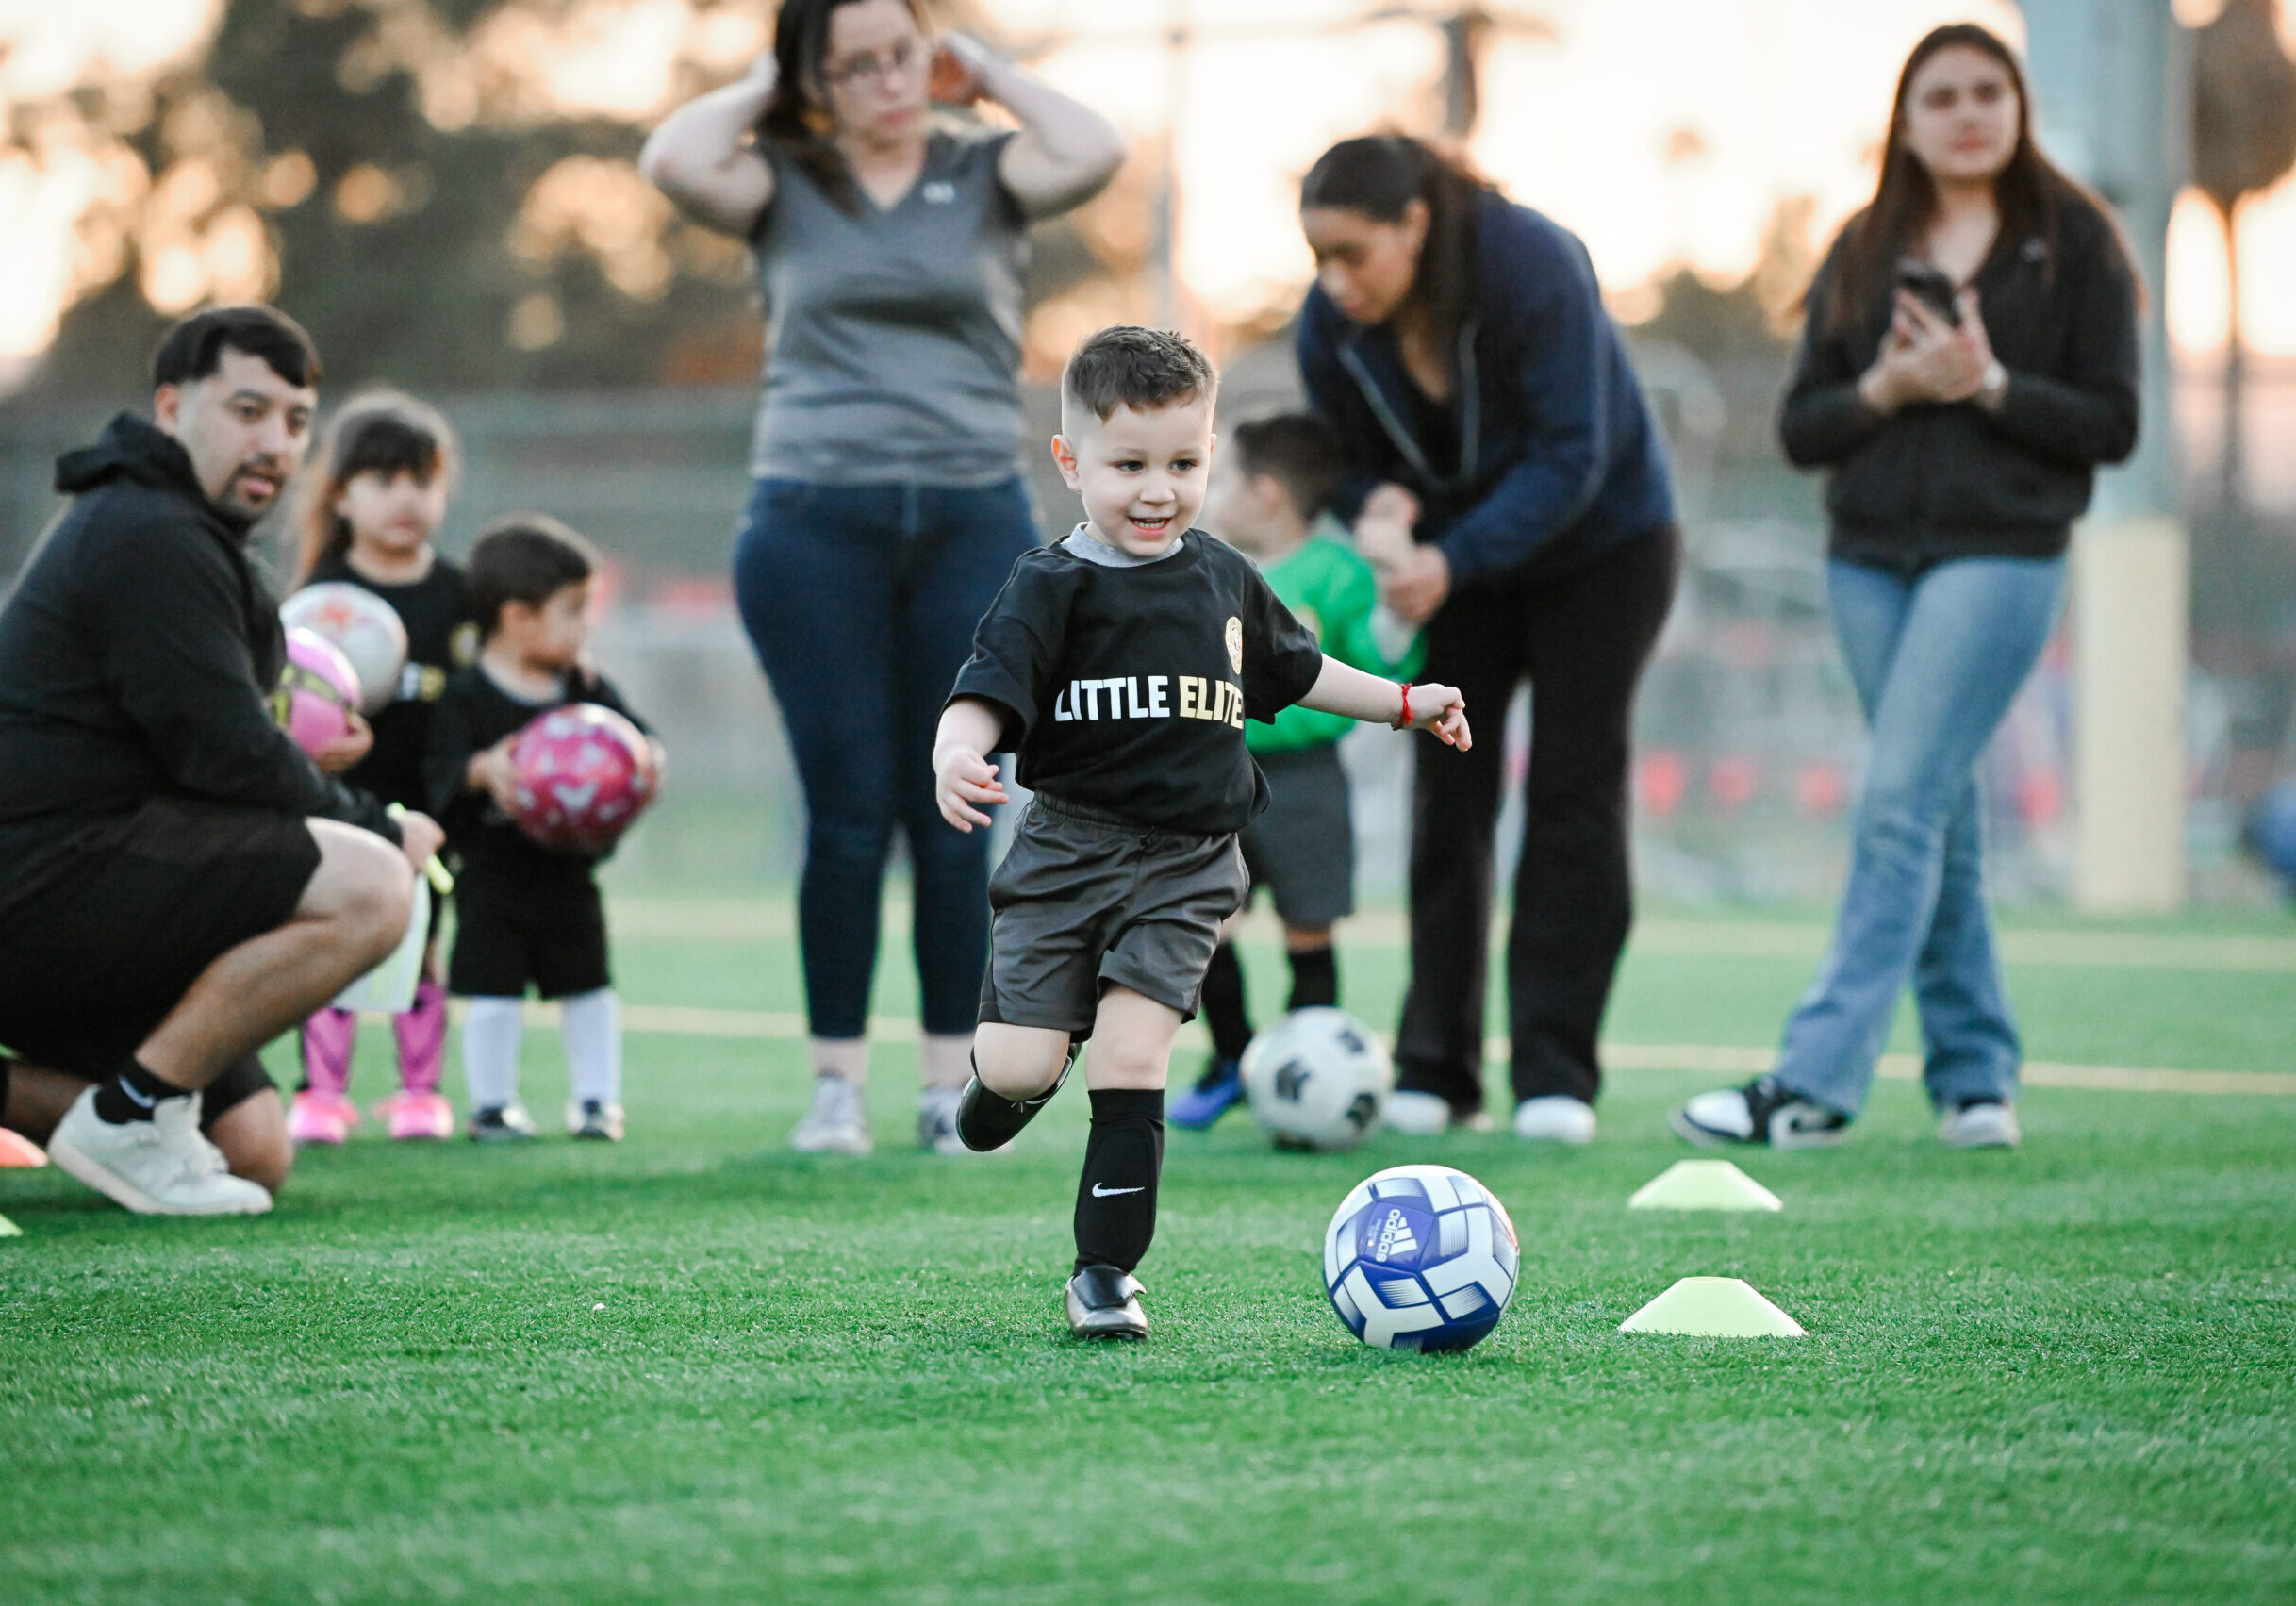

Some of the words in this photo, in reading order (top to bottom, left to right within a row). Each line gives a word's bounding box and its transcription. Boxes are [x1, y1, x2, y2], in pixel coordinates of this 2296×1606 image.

[1055, 675, 1171, 722] LITTLE
[1179, 675, 1244, 730] ELITE
[1375, 1208, 1401, 1263] adidas
